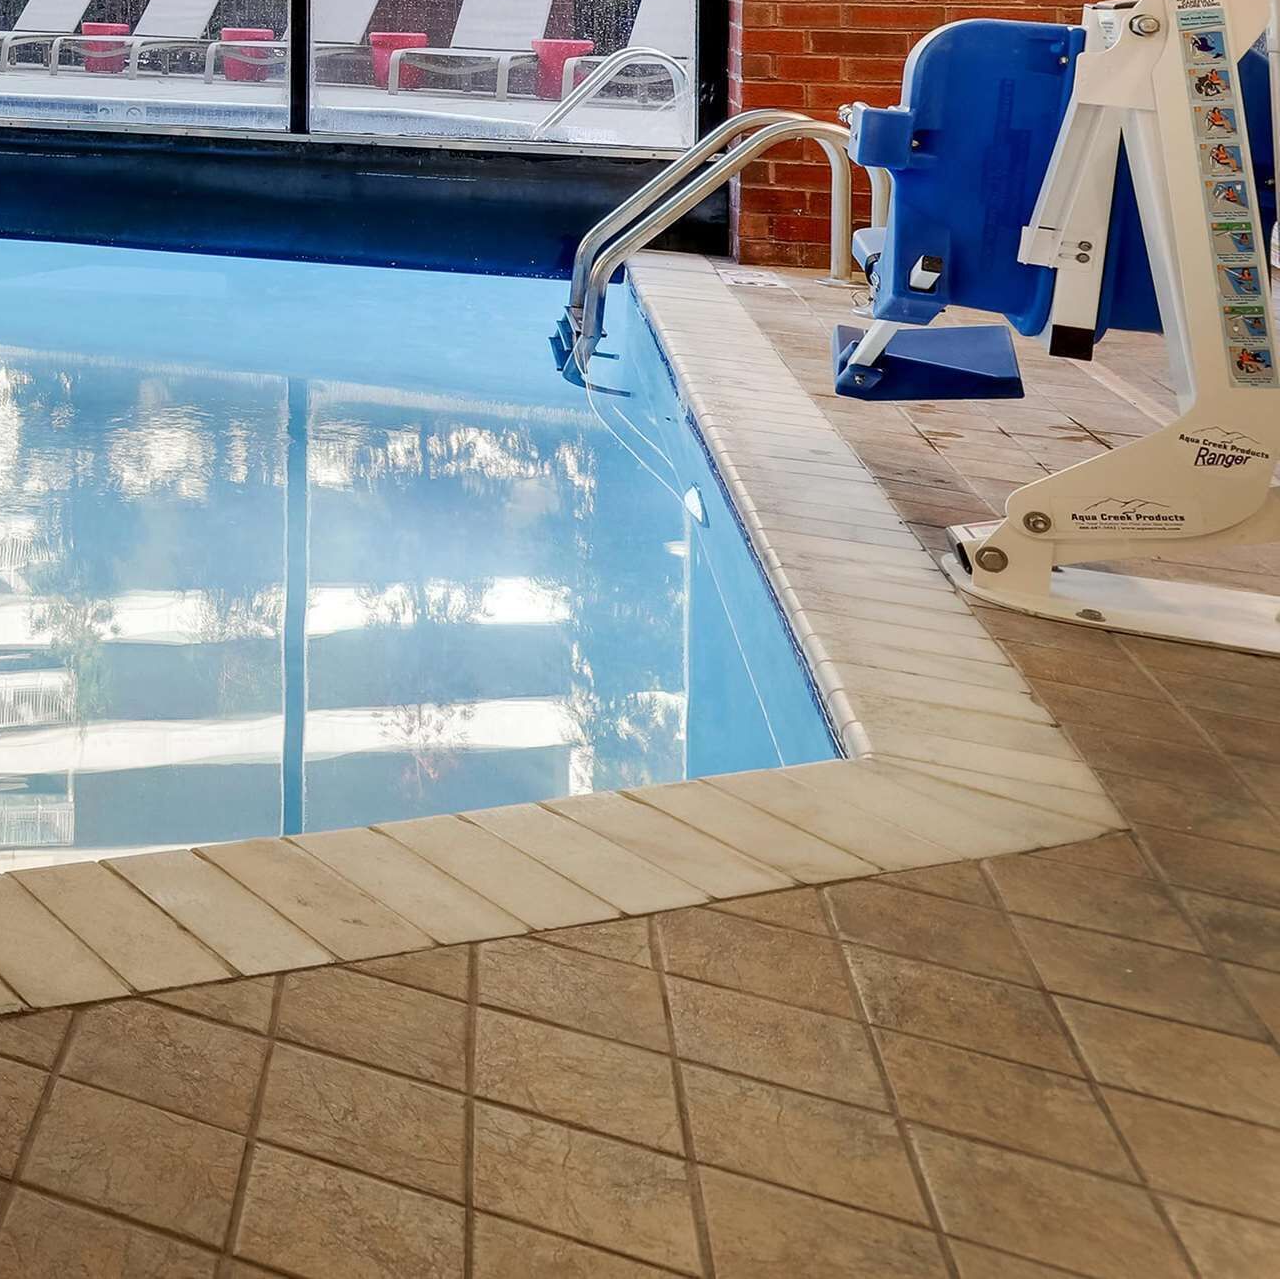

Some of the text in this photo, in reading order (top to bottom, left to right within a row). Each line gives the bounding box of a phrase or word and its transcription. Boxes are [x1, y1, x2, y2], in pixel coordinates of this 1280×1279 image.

[1179, 434, 1269, 459] Aqua Creek Products
[1194, 447, 1252, 468] Ranger
[1072, 513, 1185, 522] Aqua Creek Products
